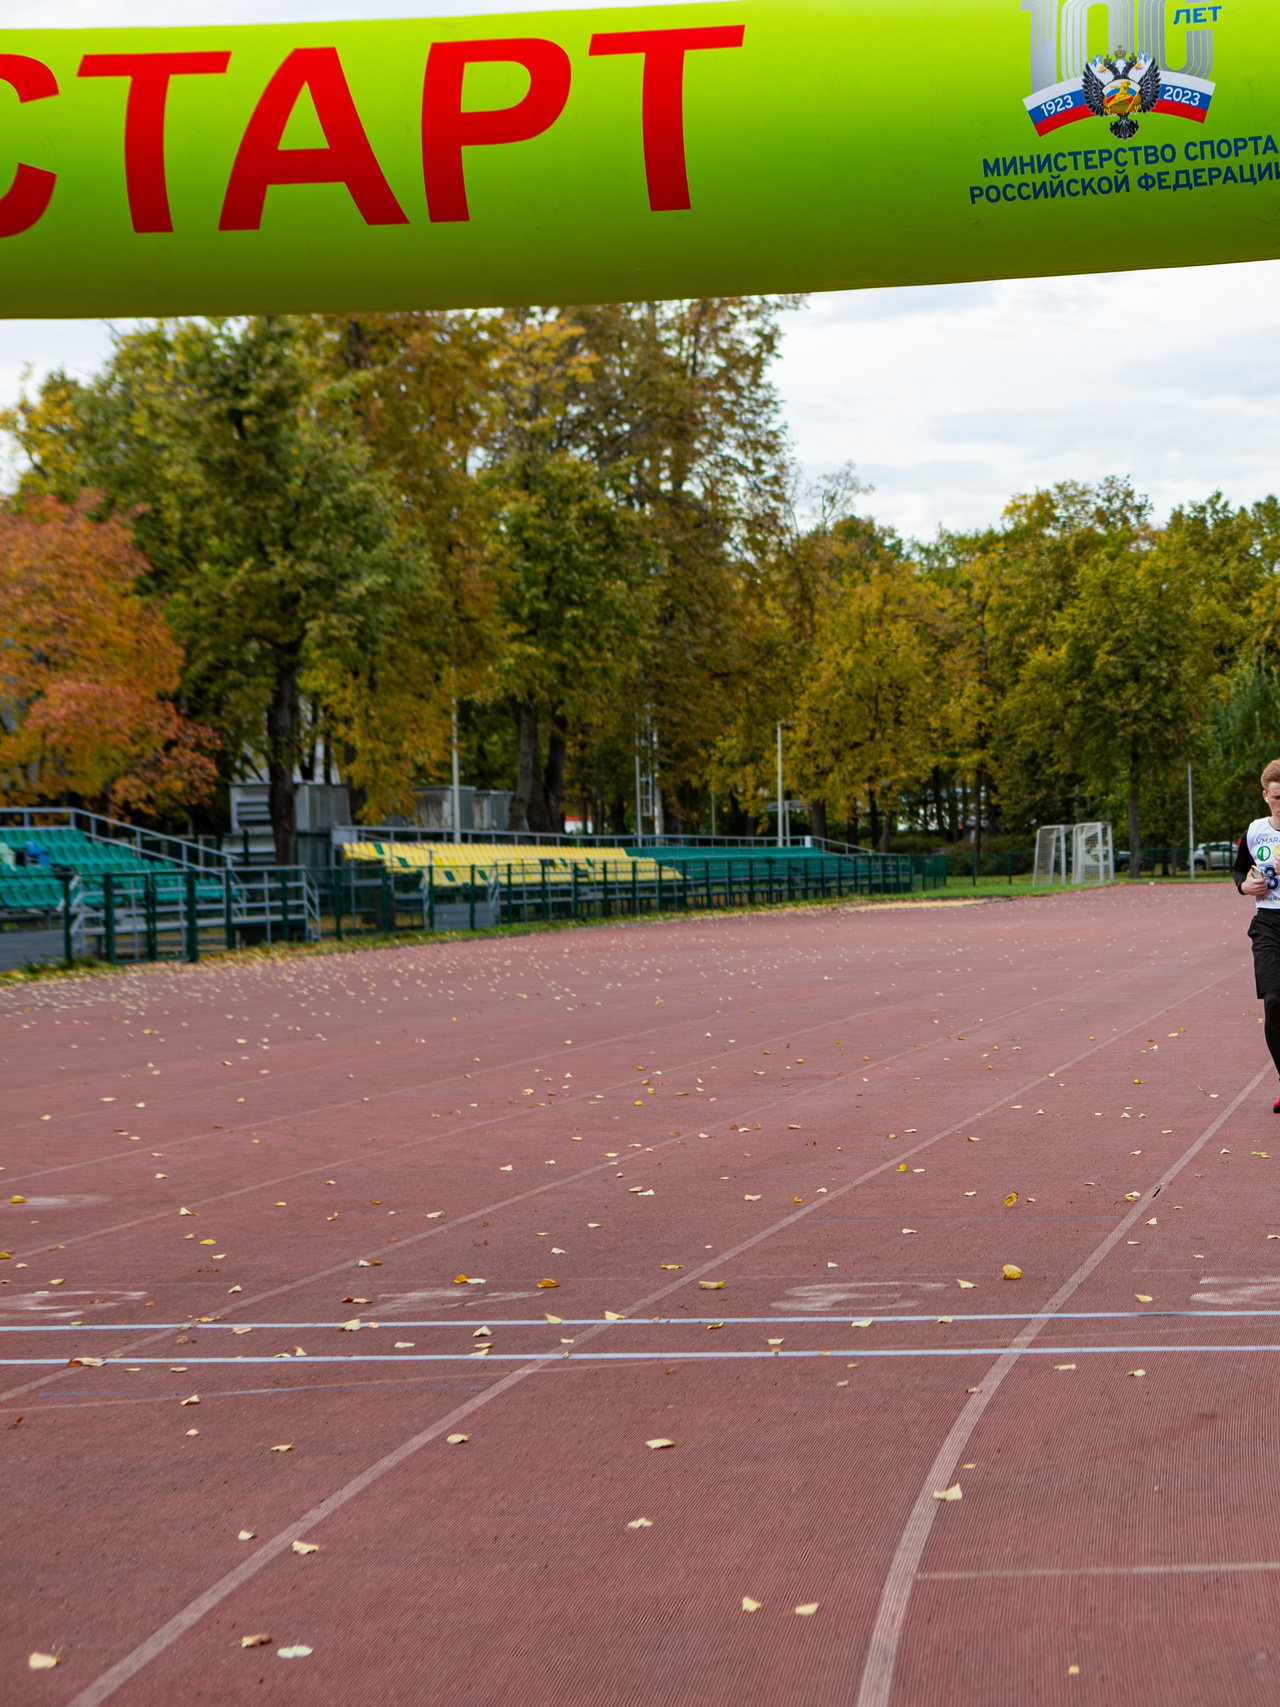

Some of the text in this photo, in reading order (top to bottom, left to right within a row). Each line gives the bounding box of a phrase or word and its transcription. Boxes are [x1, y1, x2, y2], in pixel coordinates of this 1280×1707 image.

[1173, 5, 1222, 25] ЛЕТ
[1040, 95, 1074, 117] 1923
[1163, 86, 1200, 106] 2023
[982, 134, 1279, 178] МИНИСТЕРСТВО СПОРТА
[969, 169, 1131, 204] РОССИЙСКОЙ
